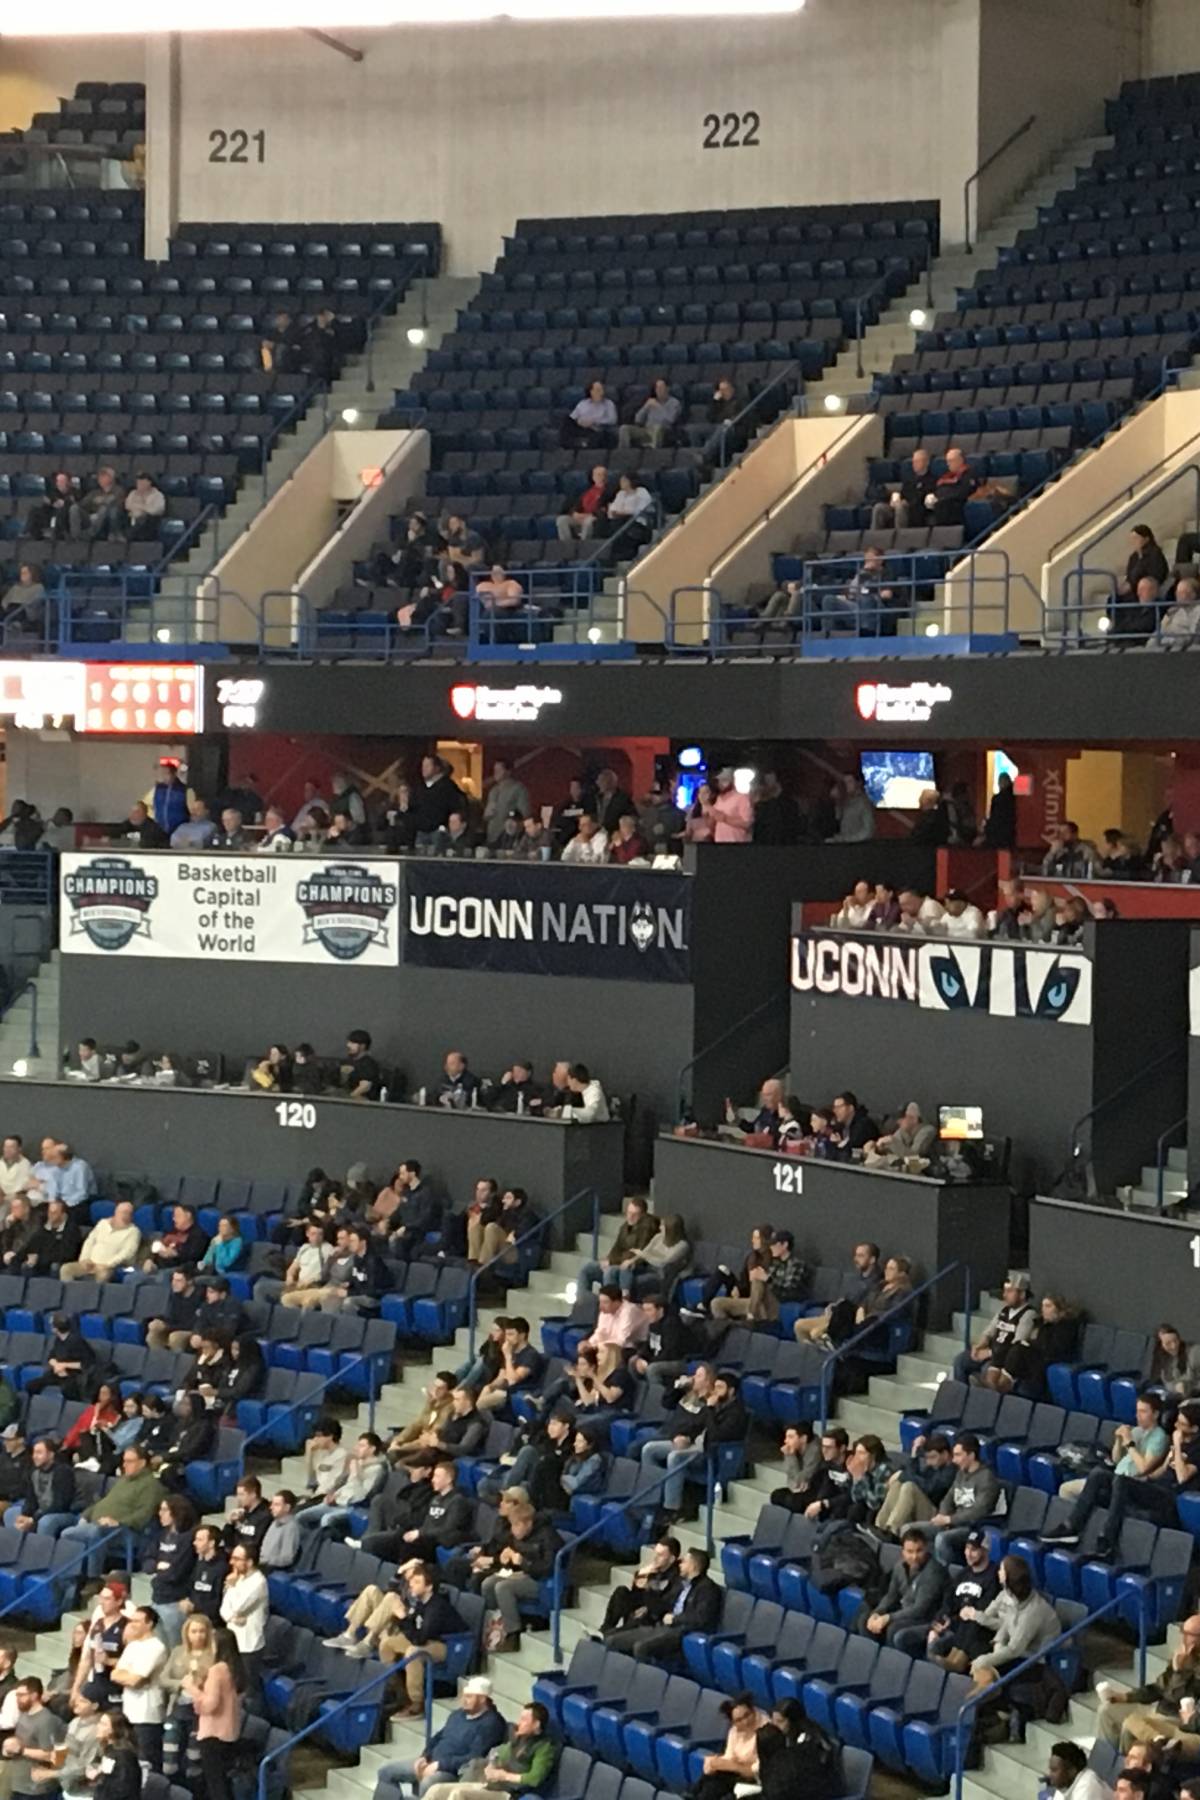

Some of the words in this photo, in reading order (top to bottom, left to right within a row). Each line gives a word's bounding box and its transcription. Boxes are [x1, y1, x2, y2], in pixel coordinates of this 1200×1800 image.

[702, 111, 761, 149] 222
[208, 129, 267, 164] 221
[177, 862, 277, 884] Basketball
[65, 876, 157, 896] CHAMPIONS
[193, 886, 261, 909] Capital
[297, 884, 396, 904] CHAMPIONS
[198, 911, 218, 929] of
[223, 910, 255, 930] the
[409, 895, 534, 941] UCONN
[541, 900, 685, 951] NATIN
[198, 933, 256, 953] World
[790, 936, 918, 1001] UCONN
[275, 1101, 317, 1129] 120
[772, 1161, 803, 1195] 121
